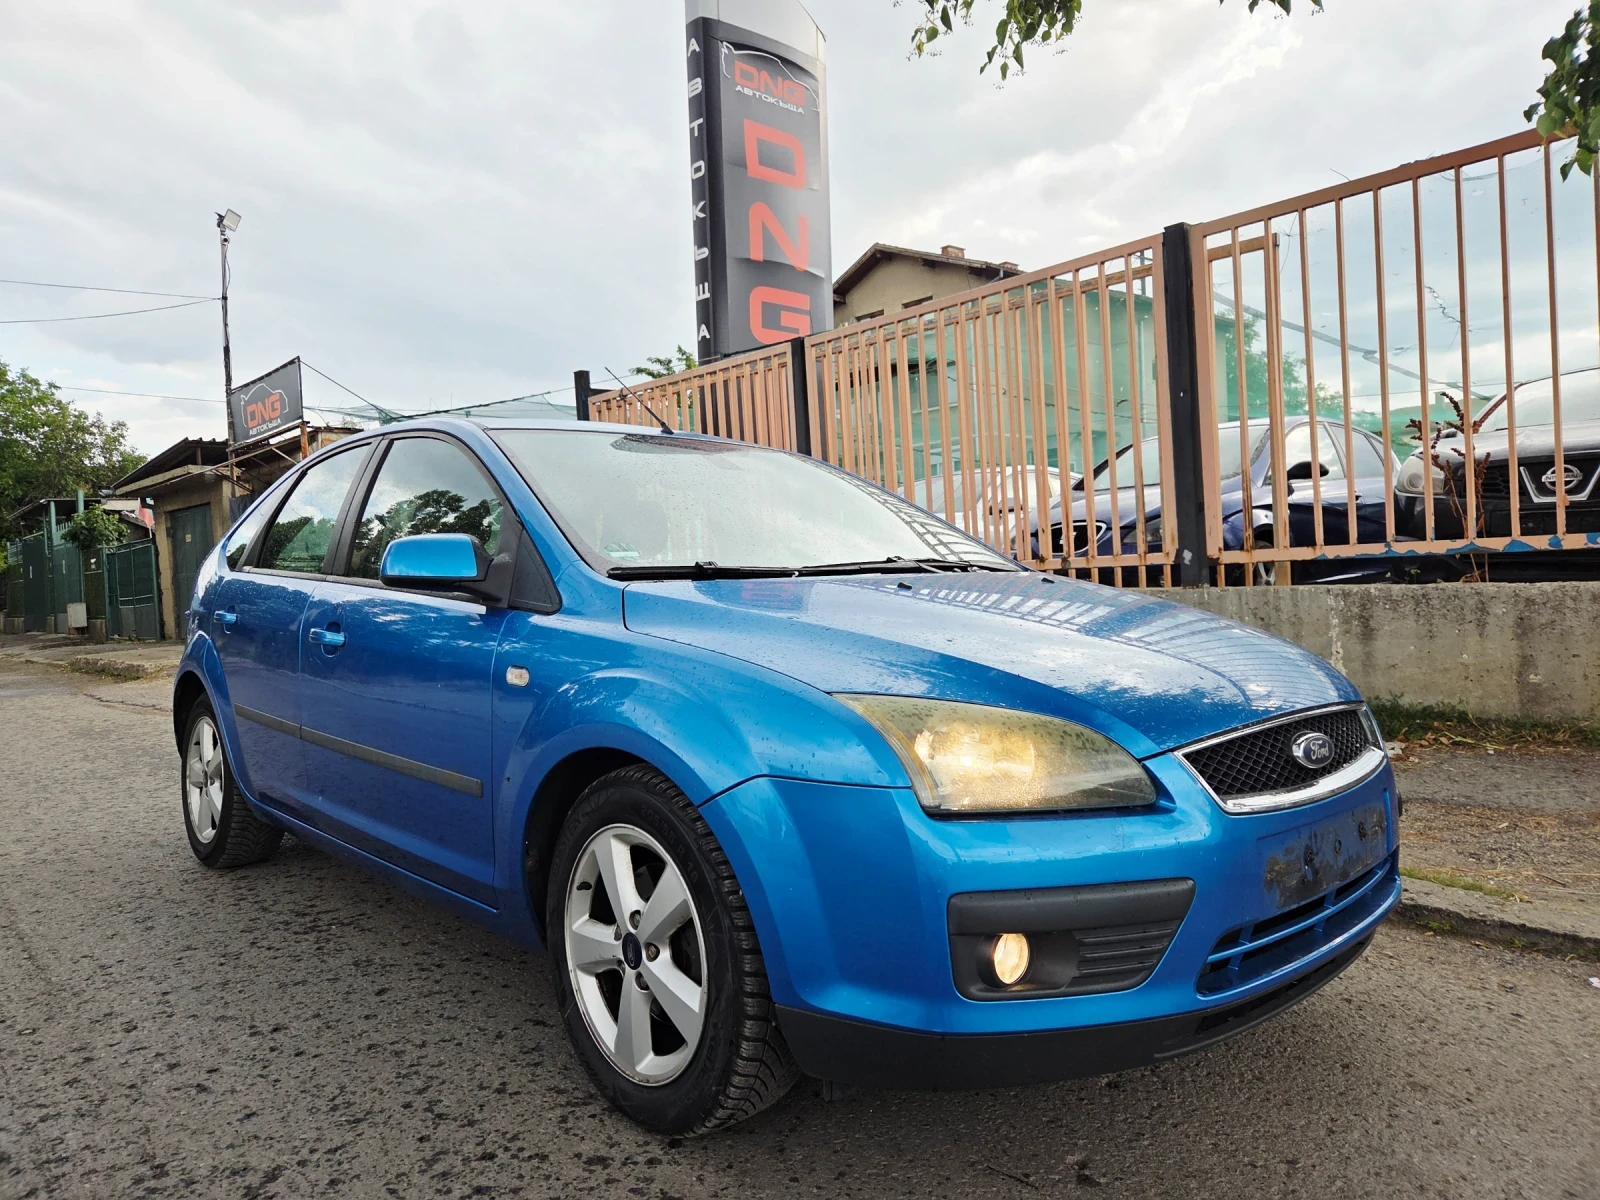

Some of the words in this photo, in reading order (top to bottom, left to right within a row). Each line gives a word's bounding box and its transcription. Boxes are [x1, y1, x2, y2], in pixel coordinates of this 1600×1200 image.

[734, 59, 806, 107] DNG
[743, 117, 811, 345] DNG
[246, 392, 281, 429] DNG
[1545, 473, 1578, 481] NIAN
[1310, 740, 1329, 760] Ford
